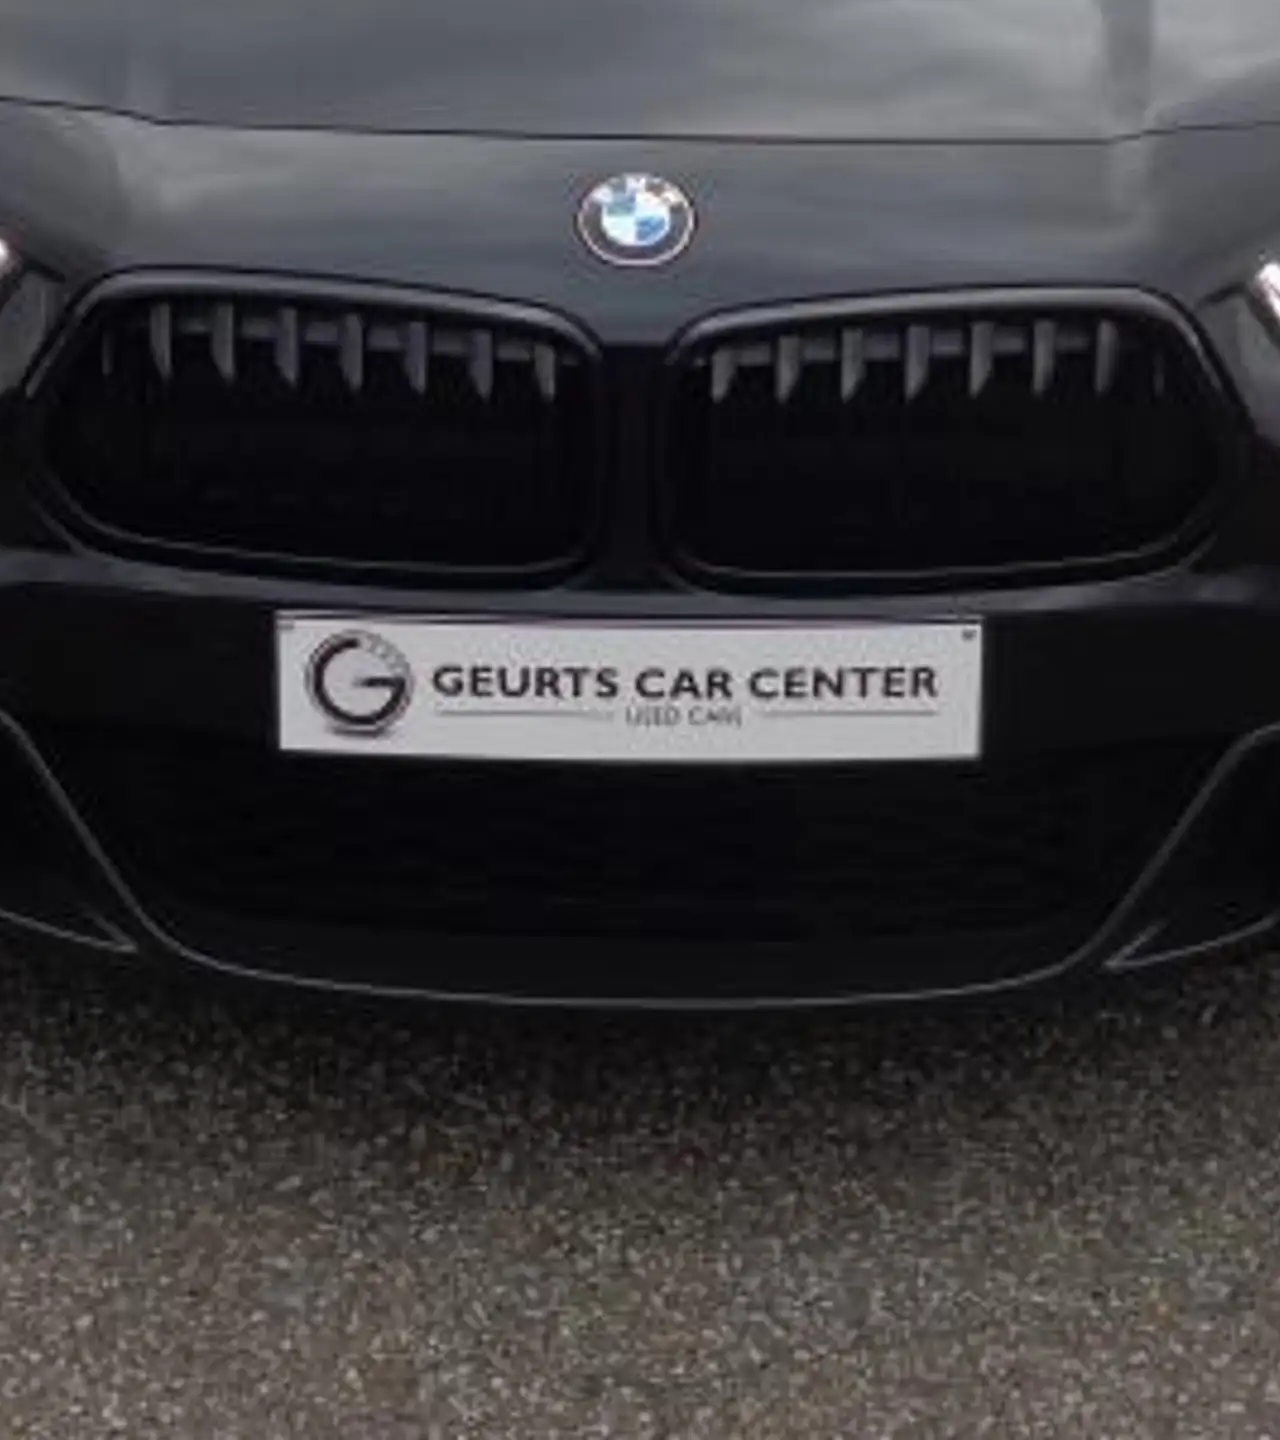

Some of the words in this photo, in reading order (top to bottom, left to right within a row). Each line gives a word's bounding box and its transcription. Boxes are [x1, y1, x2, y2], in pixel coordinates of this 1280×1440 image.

[432, 666, 619, 700] GEURTS
[634, 667, 734, 700] CAR
[748, 666, 938, 699] CENTER
